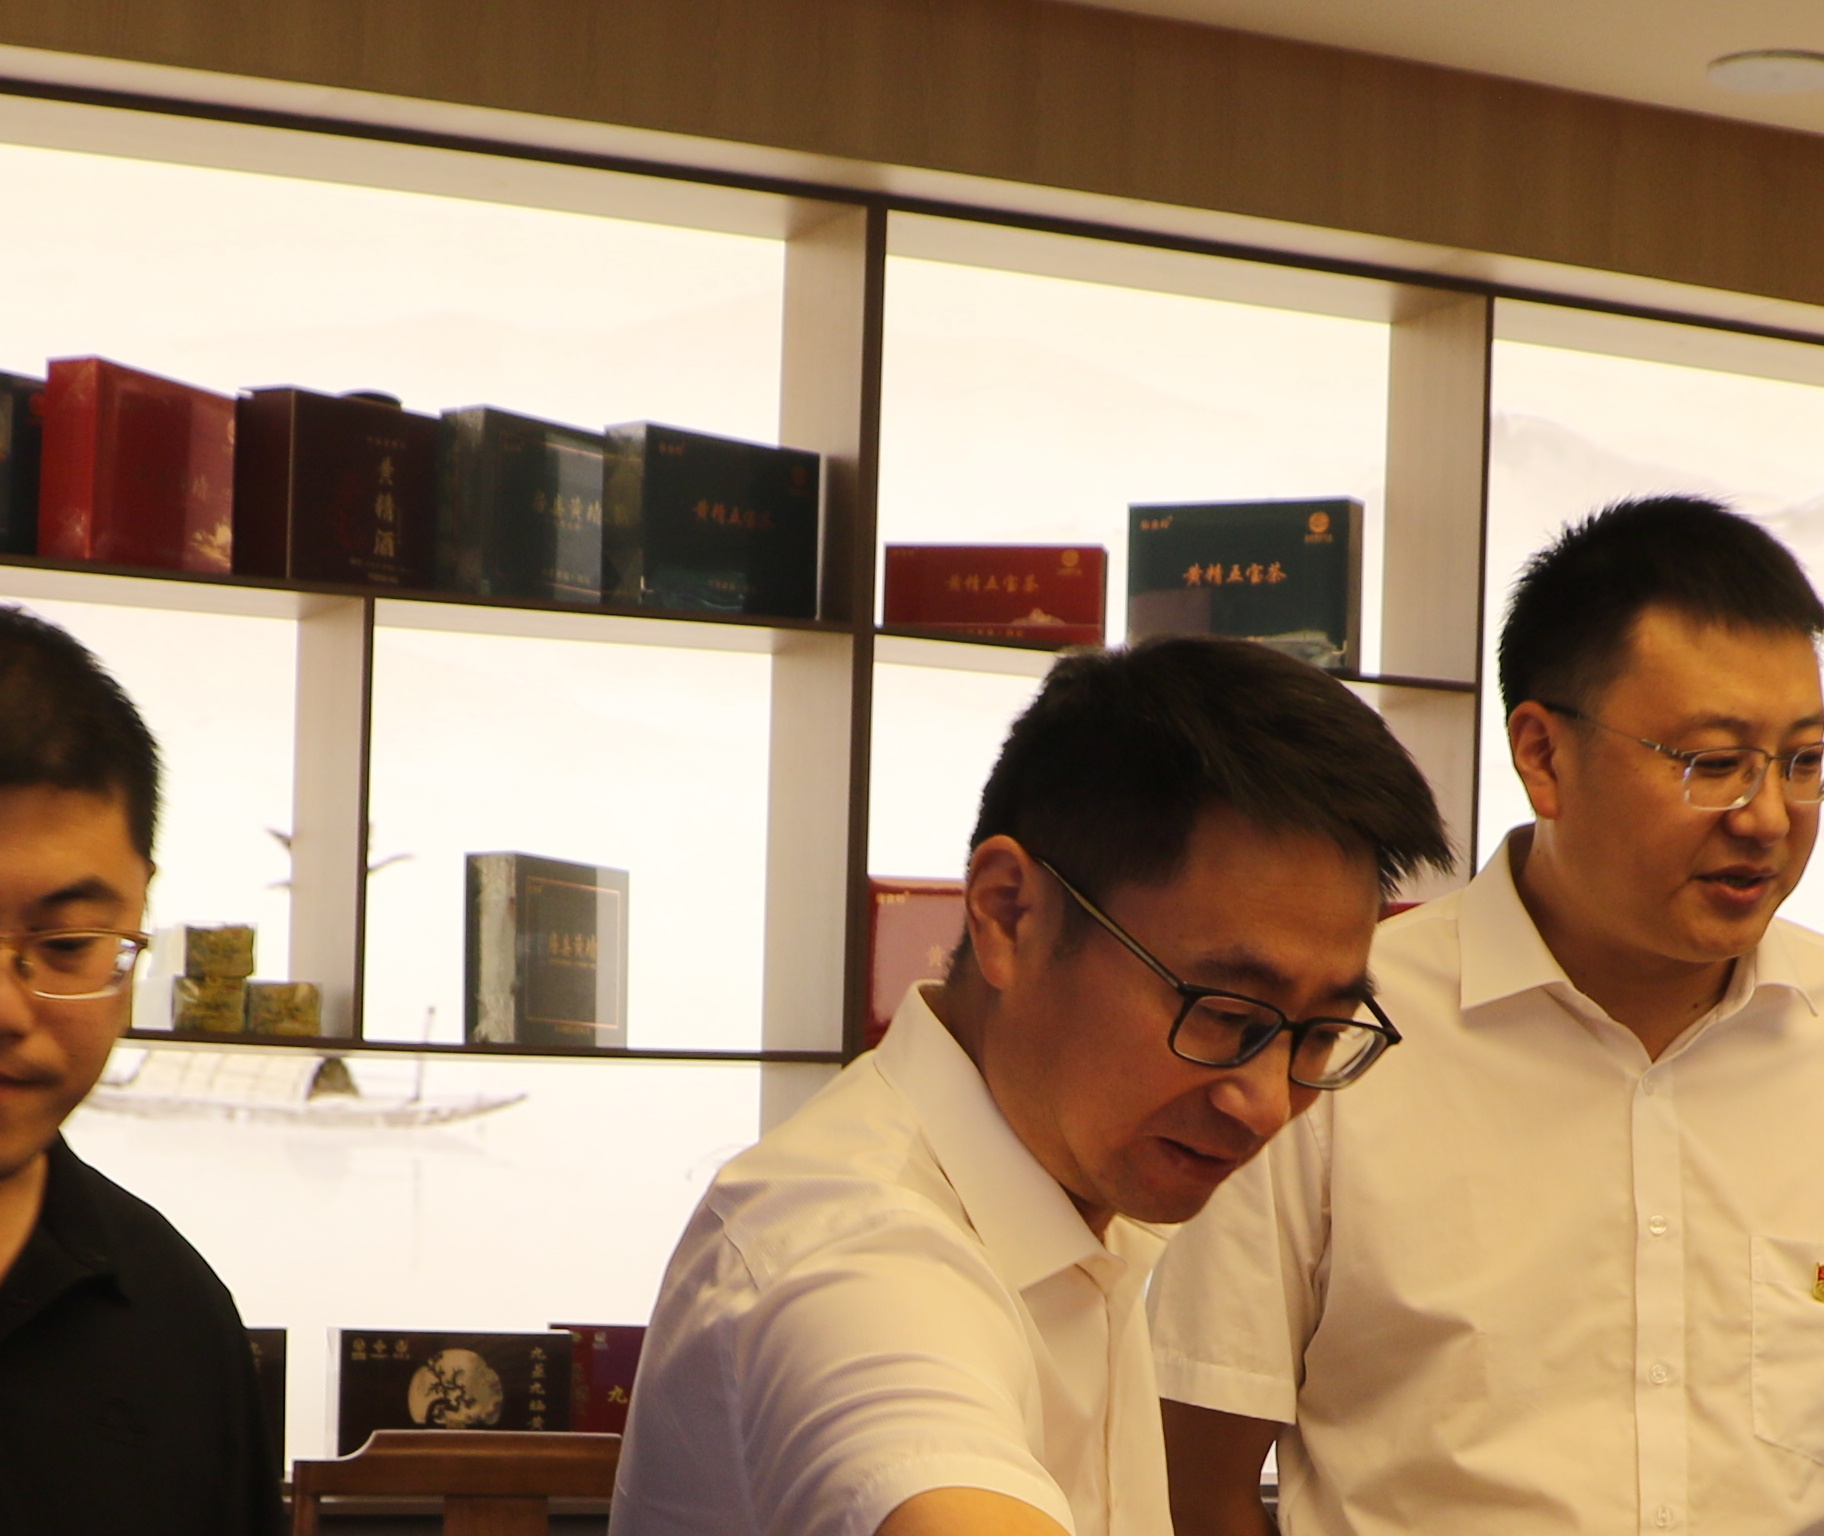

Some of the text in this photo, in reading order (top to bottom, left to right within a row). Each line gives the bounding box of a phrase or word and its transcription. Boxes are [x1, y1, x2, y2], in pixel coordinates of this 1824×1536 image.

[1183, 562, 1287, 585] 黄精五宝茶
